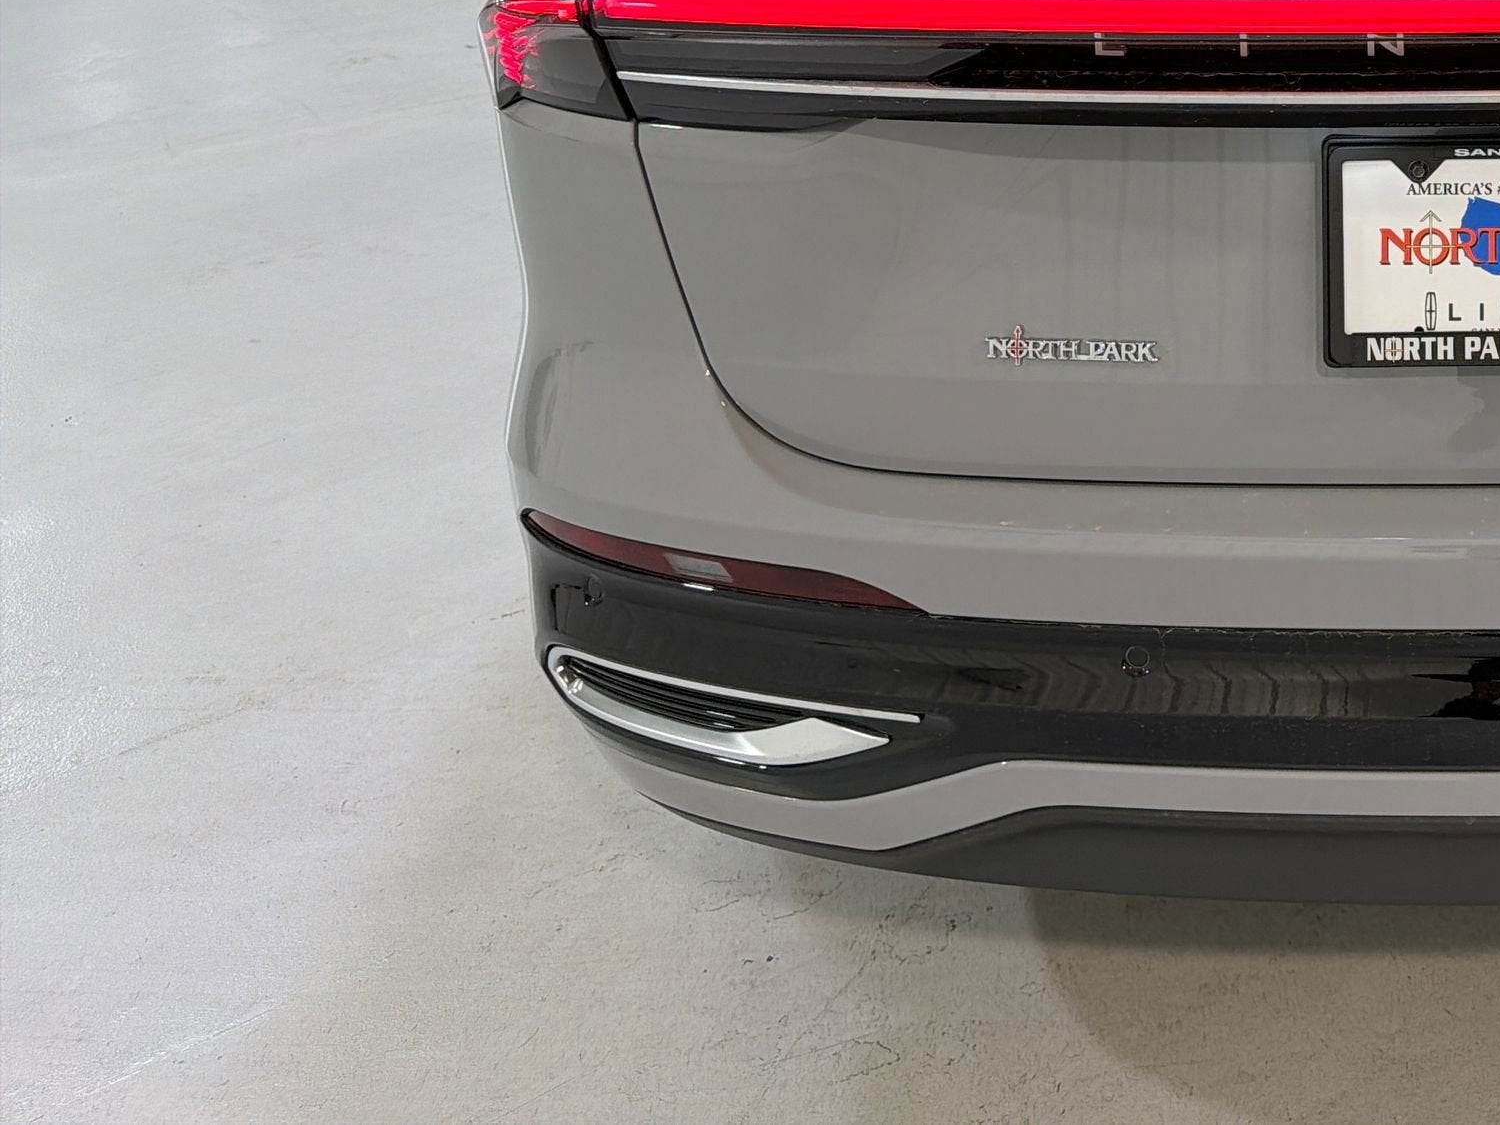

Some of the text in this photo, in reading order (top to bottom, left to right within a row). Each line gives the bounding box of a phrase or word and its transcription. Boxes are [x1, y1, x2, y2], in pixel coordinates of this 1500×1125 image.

[984, 337, 1159, 363] NORTH PARK
[1366, 336, 1455, 362] NORTH
